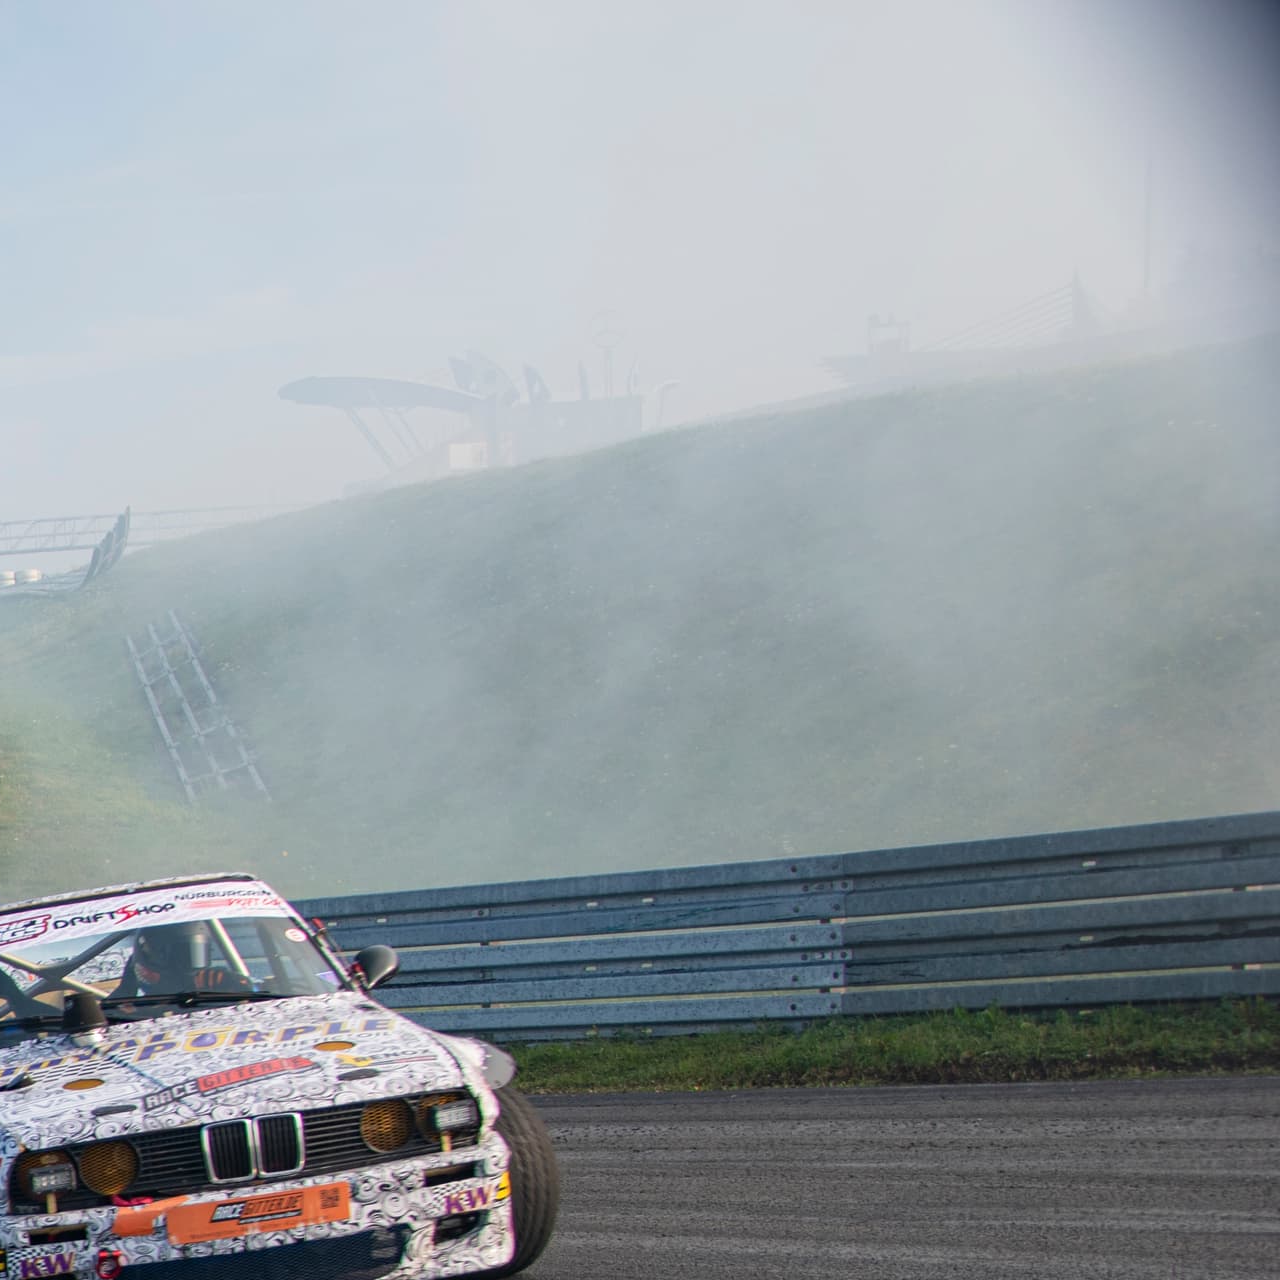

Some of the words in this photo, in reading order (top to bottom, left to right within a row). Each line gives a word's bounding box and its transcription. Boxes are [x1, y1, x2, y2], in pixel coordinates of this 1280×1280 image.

[53, 902, 175, 930] DRIFTSHOP
[132, 1018, 395, 1063] PURPLE
[444, 1184, 496, 1216] KW
[19, 1252, 76, 1280] KW
